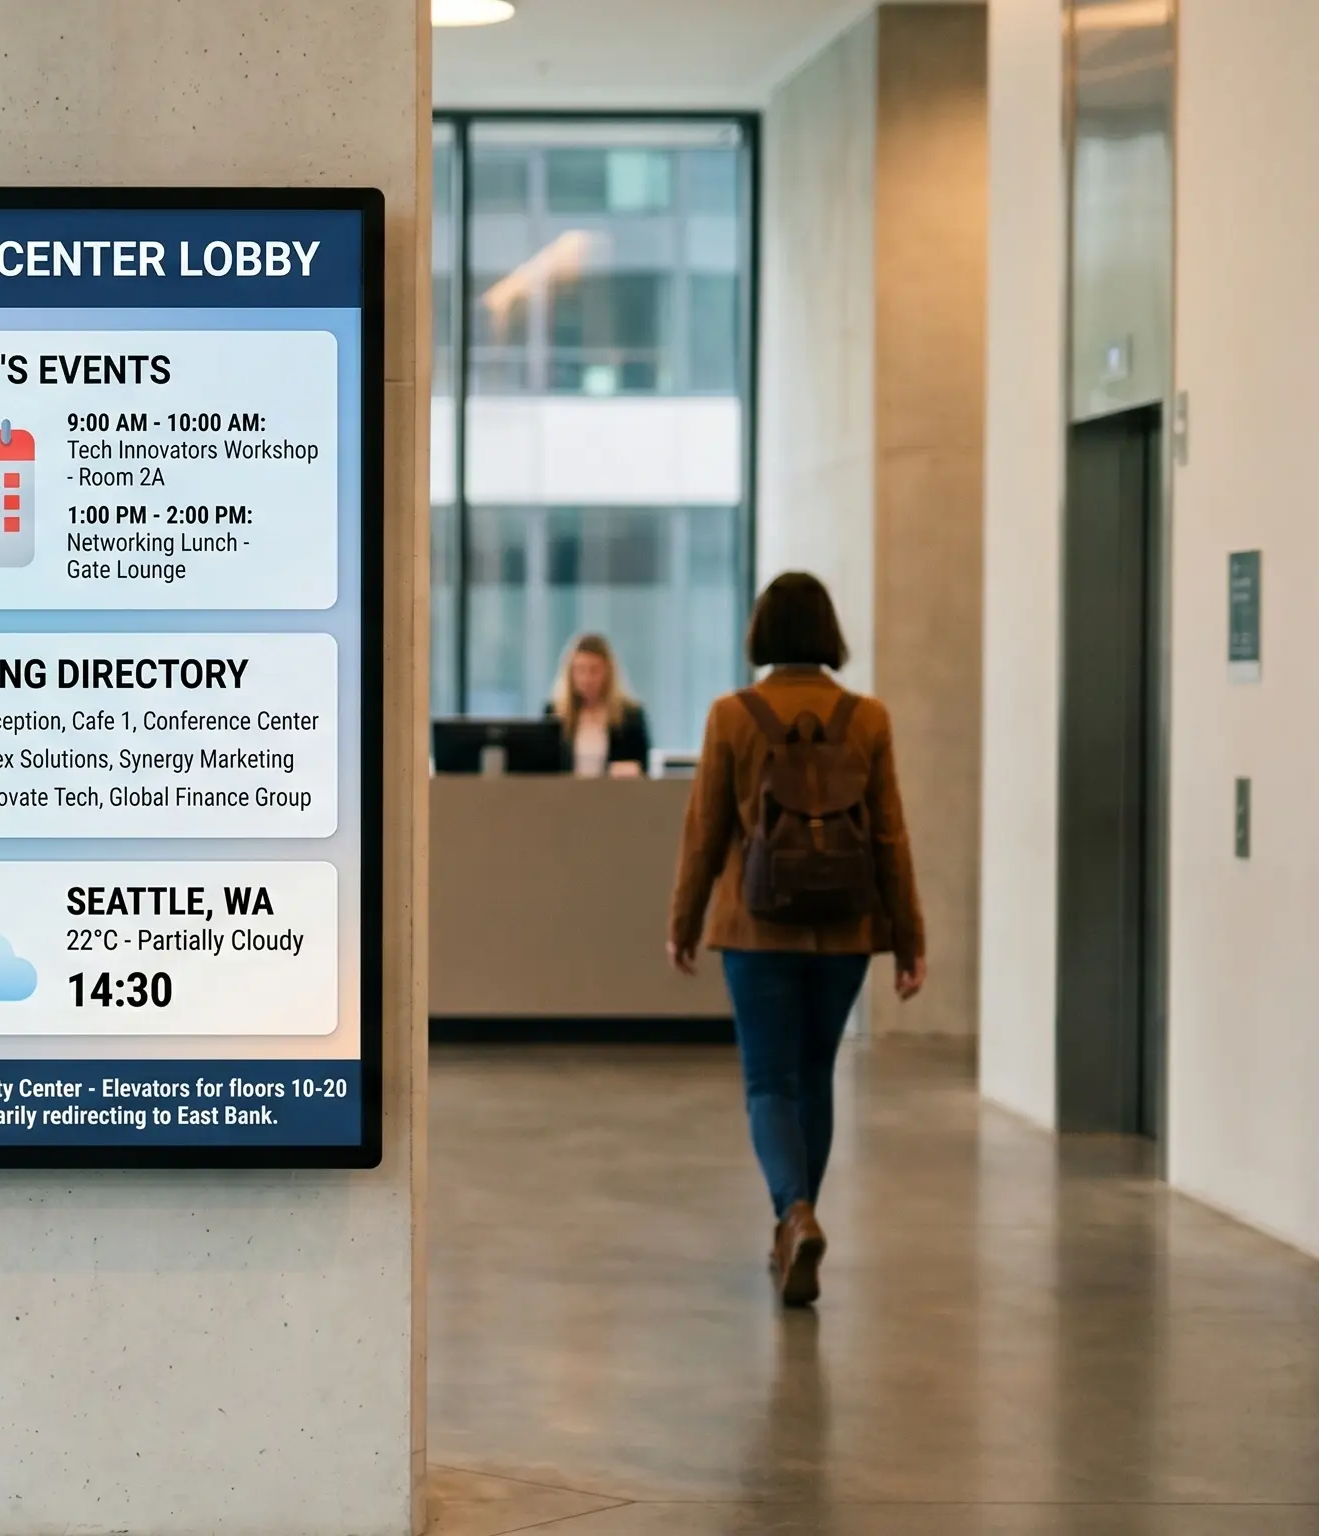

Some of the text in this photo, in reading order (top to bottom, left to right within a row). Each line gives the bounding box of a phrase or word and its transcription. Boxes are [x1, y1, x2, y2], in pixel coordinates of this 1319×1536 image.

[181, 241, 320, 276] LOBBY
[40, 355, 170, 384] EVENTS
[68, 413, 109, 431] 9:00
[116, 413, 147, 431] AM
[168, 413, 221, 431] 10:00
[228, 413, 265, 431] AM:
[67, 439, 318, 464] Tech Innovators Workshop
[80, 467, 133, 486] Room
[140, 467, 165, 486] 2A
[69, 506, 109, 524] 1:00
[117, 506, 146, 524] PM
[167, 506, 208, 524] 2:00
[216, 506, 252, 524] PM:
[68, 532, 174, 556] Networking
[182, 532, 237, 551] Lunch
[68, 560, 185, 583] Gate Lounge
[59, 659, 249, 689] DIRECTORY
[73, 710, 114, 730] Cafe
[122, 711, 136, 733] 1,
[144, 710, 250, 730] Conference
[258, 711, 319, 730] Center
[21, 748, 113, 771] Solutions,
[120, 749, 193, 773] Synergy
[201, 748, 293, 773] Marketing
[54, 786, 103, 809] Tech,
[110, 786, 168, 806] Global
[177, 787, 249, 806] Finance
[256, 787, 311, 811] Group
[67, 887, 274, 921] SEATTLE, WA
[67, 929, 117, 950] 22°C
[139, 929, 224, 956] Partially
[232, 929, 304, 956] Cloudy
[69, 972, 172, 1007] 14:30
[19, 1079, 82, 1097] Center
[103, 1078, 190, 1097] Elevators
[196, 1078, 223, 1097] for
[229, 1078, 284, 1097] floors
[292, 1079, 346, 1097] 10-20
[43, 1105, 146, 1129] redirecting
[152, 1107, 171, 1124] to
[178, 1106, 218, 1124] East
[225, 1105, 277, 1124] Bank.
